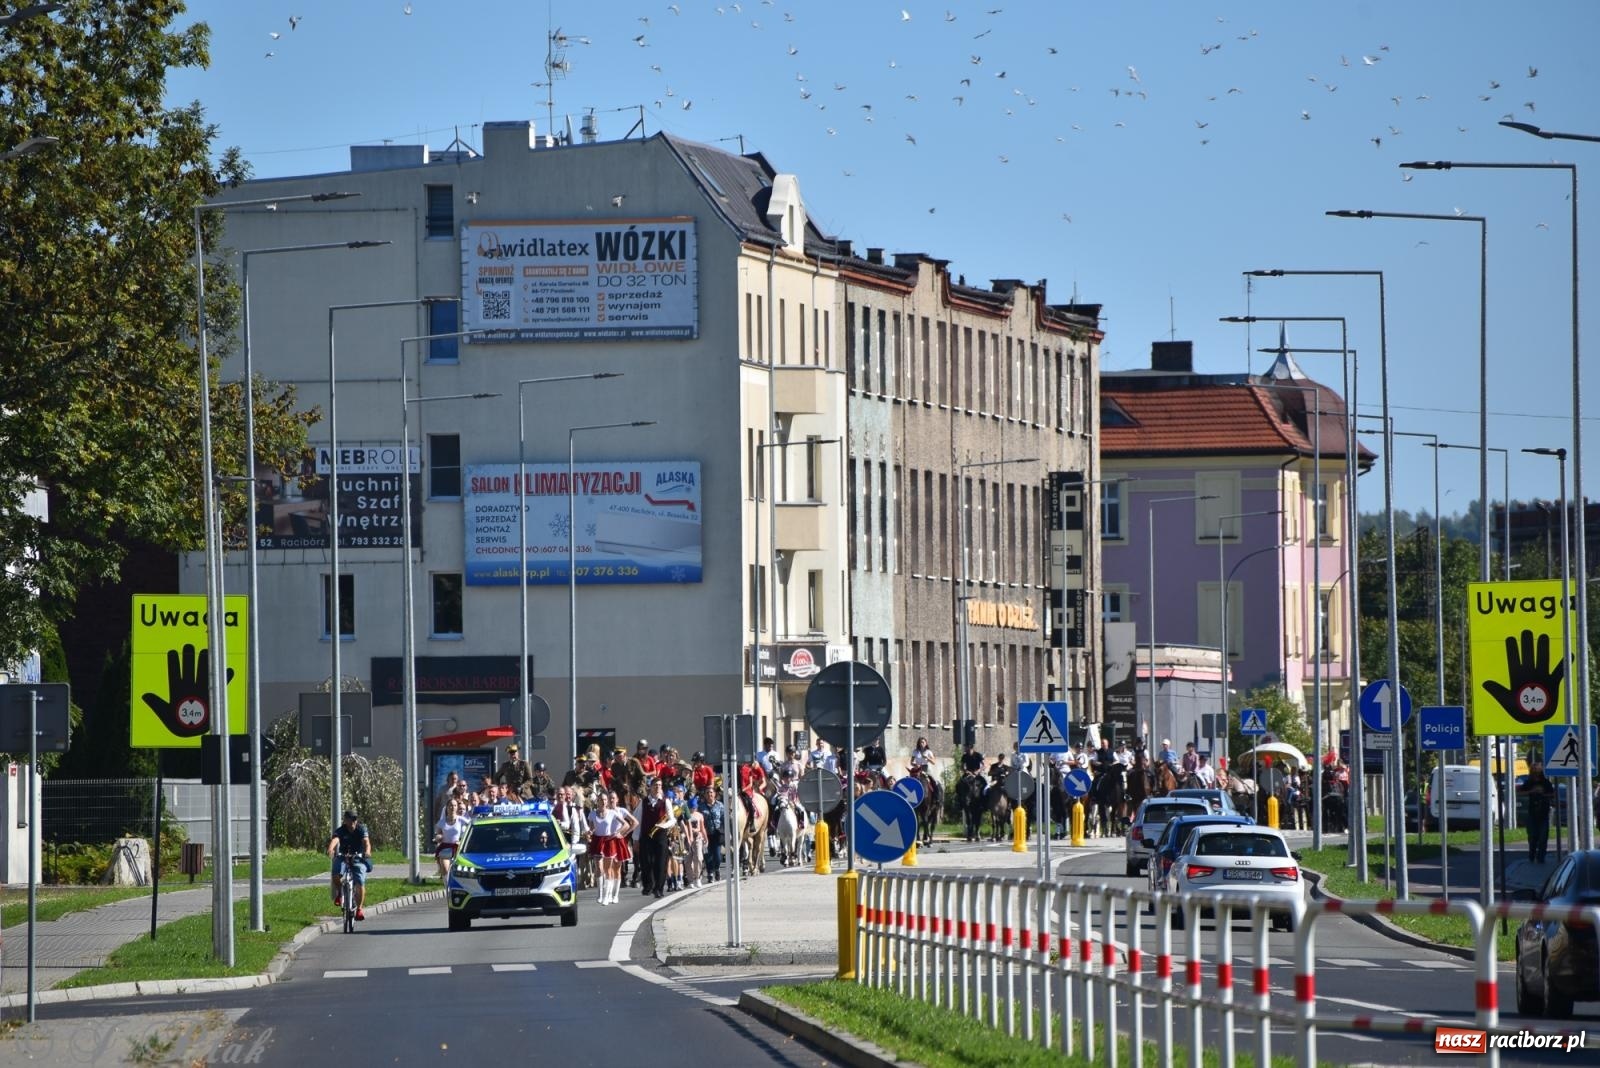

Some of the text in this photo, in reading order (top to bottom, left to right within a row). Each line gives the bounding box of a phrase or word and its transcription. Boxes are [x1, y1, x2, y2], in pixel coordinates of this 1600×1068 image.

[503, 238, 589, 258] widlatex
[595, 225, 686, 261] WÓZKI
[596, 262, 686, 274] WIDŁOWE
[597, 274, 687, 287] DO 32 TON
[608, 290, 663, 301] sprzedaż
[532, 306, 544, 314] +48
[608, 301, 661, 311] wynajem
[608, 313, 649, 321] serwis
[471, 472, 641, 496] SALON KLIMATYZACJI
[656, 471, 696, 487] ALASKA
[475, 505, 530, 513] DORADZTWO
[475, 515, 517, 523] SPRZEDAŻ
[475, 525, 511, 533] MONTAŻ
[351, 537, 369, 545] 793
[372, 537, 390, 545] 332
[475, 545, 539, 554] CHŁODNICWO
[593, 566, 614, 576] 376
[618, 565, 639, 576] 336
[473, 675, 521, 689] BARBER
[1424, 723, 1460, 735] Policja
